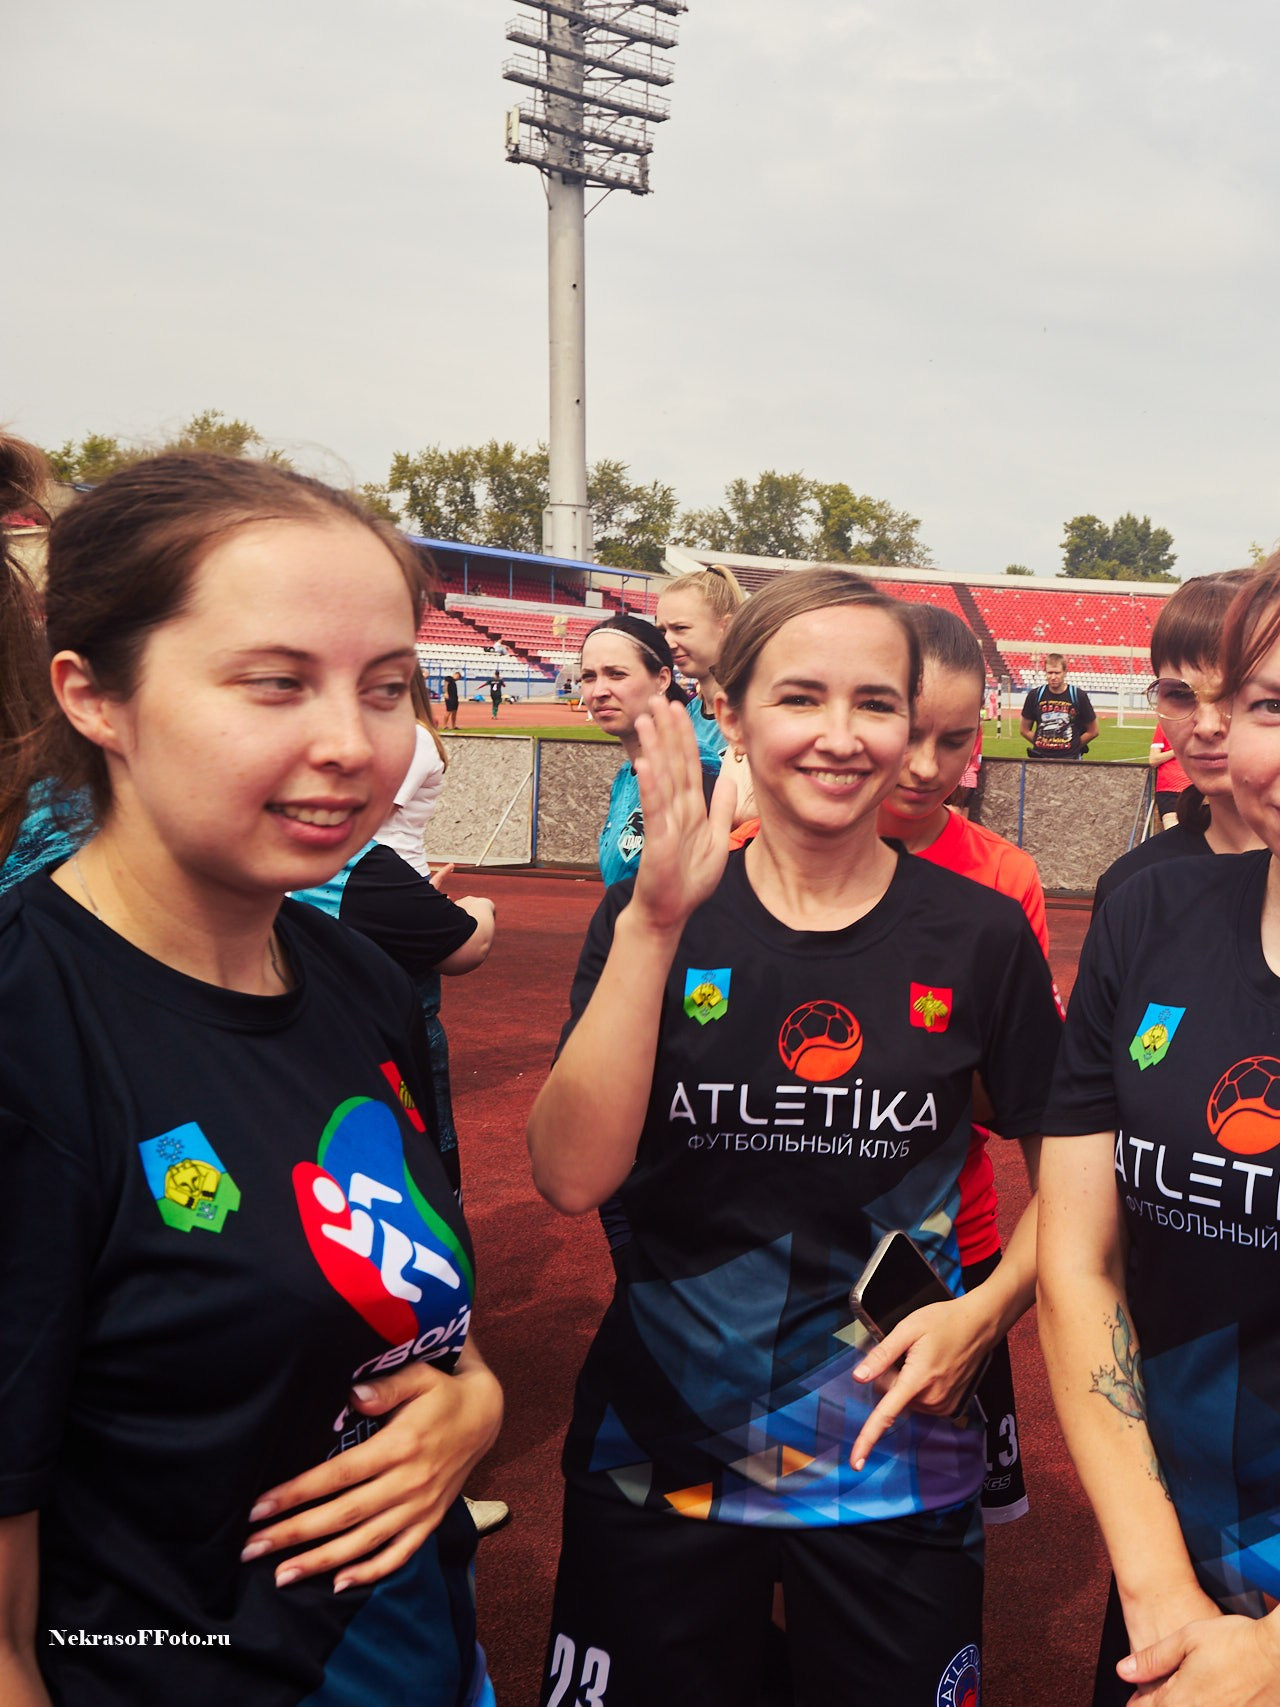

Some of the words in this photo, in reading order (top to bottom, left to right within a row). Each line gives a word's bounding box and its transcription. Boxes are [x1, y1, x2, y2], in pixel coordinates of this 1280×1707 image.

[688, 1133, 852, 1156] ФУТБОЛЬНЫЙ
[859, 1139, 911, 1159] КЛУБ
[1126, 1195, 1278, 1251] ФУТБОЛЬНЫЙ
